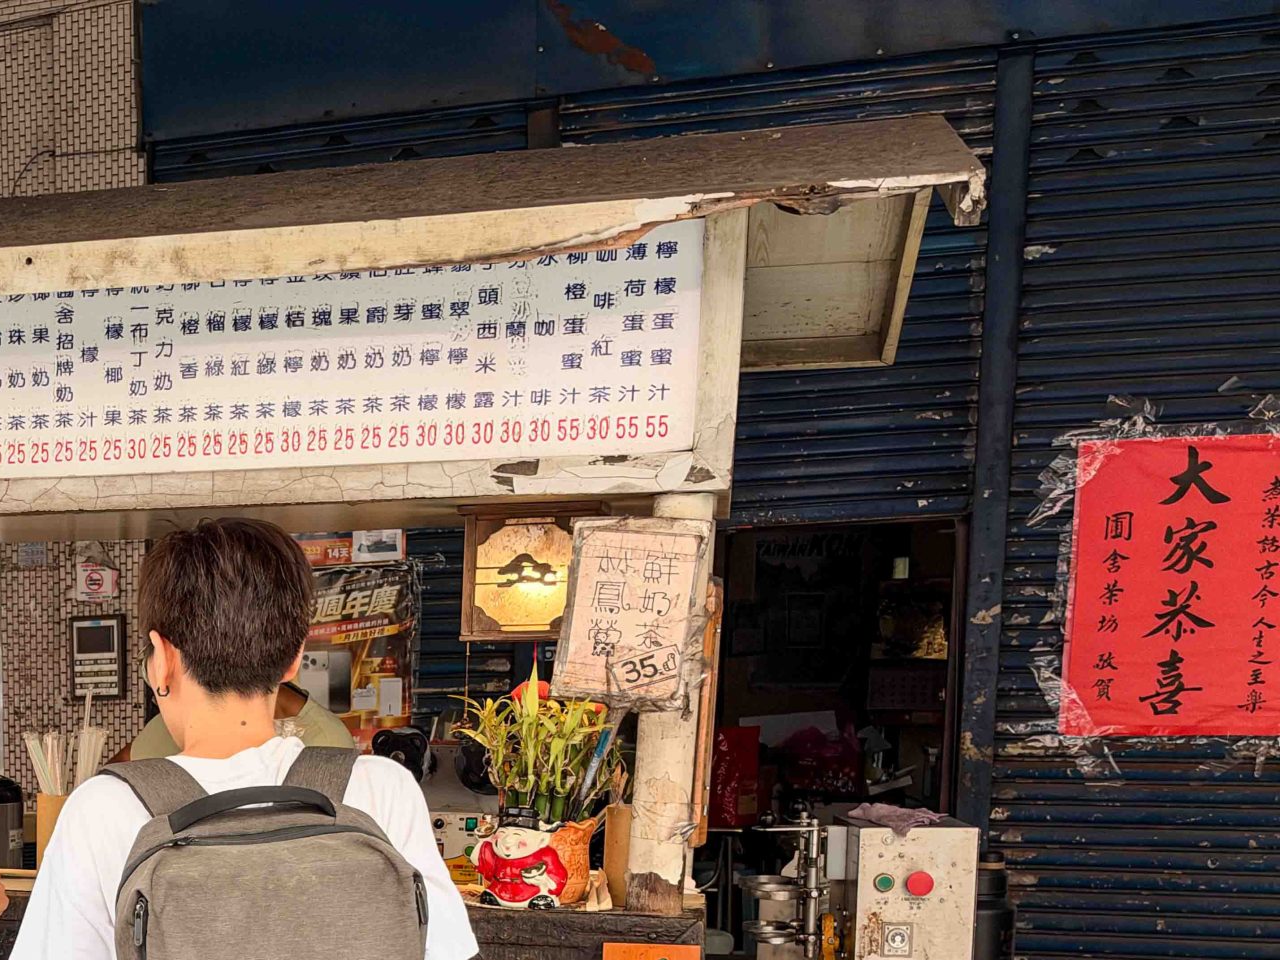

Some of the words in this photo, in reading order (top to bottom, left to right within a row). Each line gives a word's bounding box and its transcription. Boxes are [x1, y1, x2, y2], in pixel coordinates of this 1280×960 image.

[618, 243, 648, 402] 薄荷蛋蜜汁
[648, 241, 678, 401] 檸檬蛋蜜汁
[388, 426, 408, 447] 25
[416, 424, 437, 446] 30
[444, 423, 464, 445] 30
[472, 422, 493, 444] 30
[500, 421, 521, 443] 30
[529, 420, 550, 441] 30
[558, 419, 579, 440] 55
[587, 417, 609, 439] 30
[616, 416, 638, 438] 55
[646, 415, 668, 437] 55
[128, 439, 146, 459] 30
[153, 437, 171, 458] 25
[178, 436, 197, 457] 25
[203, 434, 222, 456] 25
[228, 433, 247, 455] 25
[255, 432, 273, 454] 25
[281, 431, 300, 452] 30
[307, 430, 327, 451] 25
[334, 428, 354, 450] 25
[361, 427, 381, 449] 25
[8, 444, 26, 464] 25
[31, 442, 49, 463] 25
[55, 442, 73, 462] 25
[79, 441, 97, 461] 25
[103, 440, 121, 460] 25
[1139, 445, 1231, 716] 大家恭喜
[634, 551, 680, 649] 鮮奶茶
